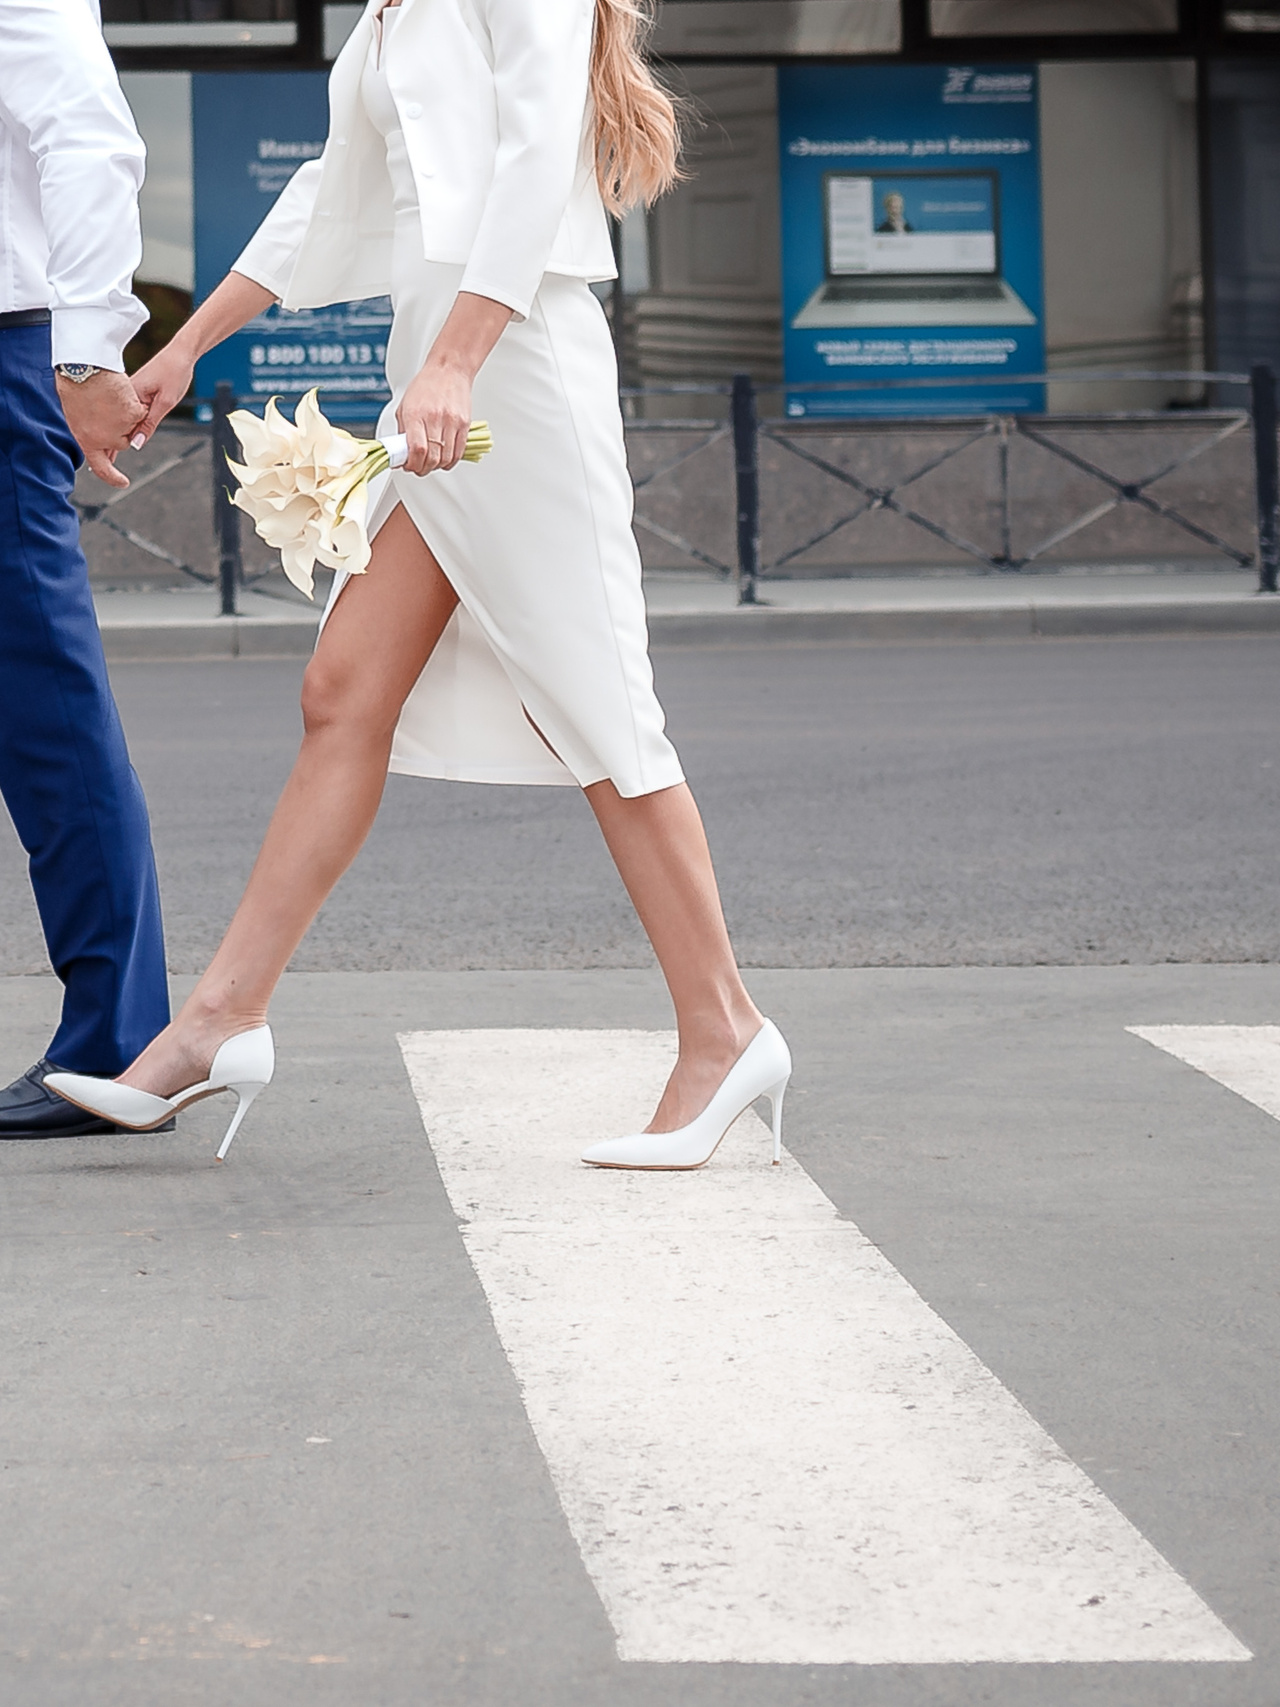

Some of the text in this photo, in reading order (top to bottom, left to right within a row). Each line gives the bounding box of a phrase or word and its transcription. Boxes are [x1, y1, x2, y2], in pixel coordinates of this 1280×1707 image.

[250, 344, 387, 365] 8 800 100 13 1
